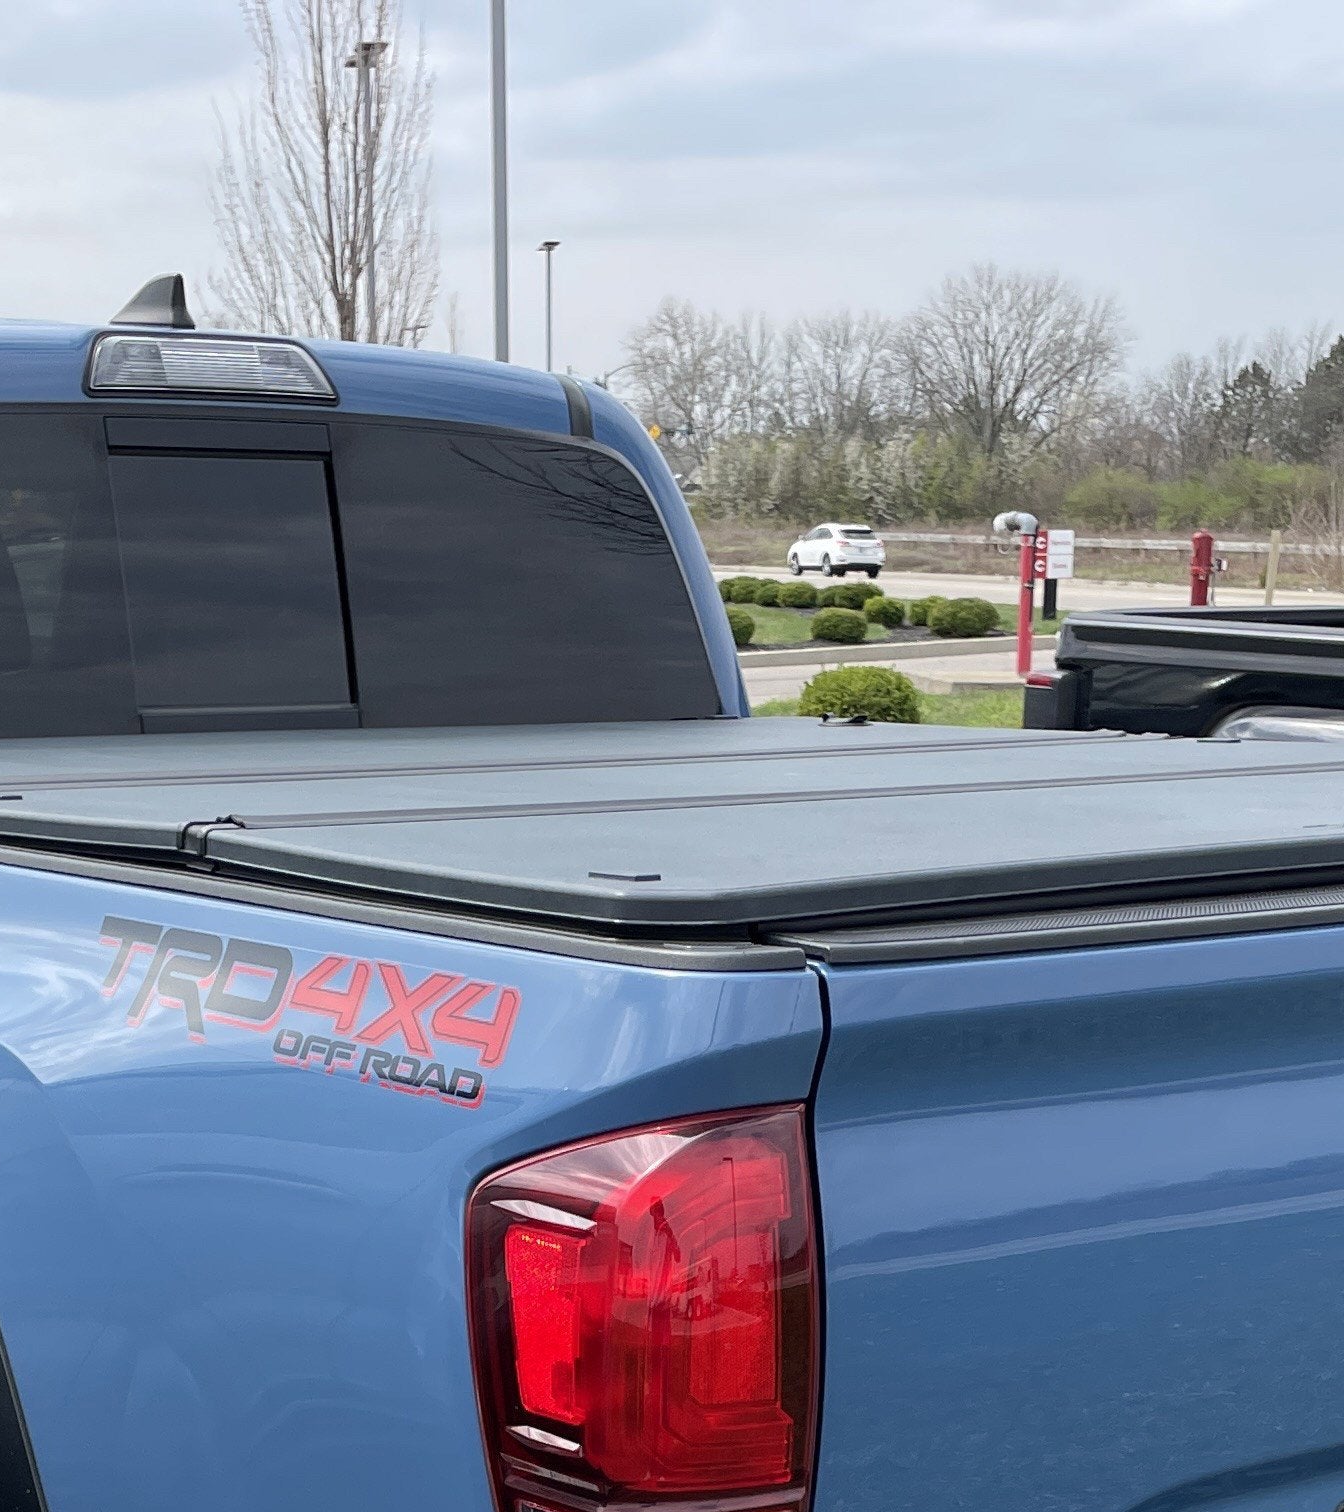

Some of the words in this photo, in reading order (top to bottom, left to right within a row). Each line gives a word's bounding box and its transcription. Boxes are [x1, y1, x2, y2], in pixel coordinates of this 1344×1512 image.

[99, 914, 294, 1044] TRD
[287, 952, 522, 1068] 4X4
[270, 1026, 358, 1076] OFF
[358, 1047, 485, 1111] ROAD
